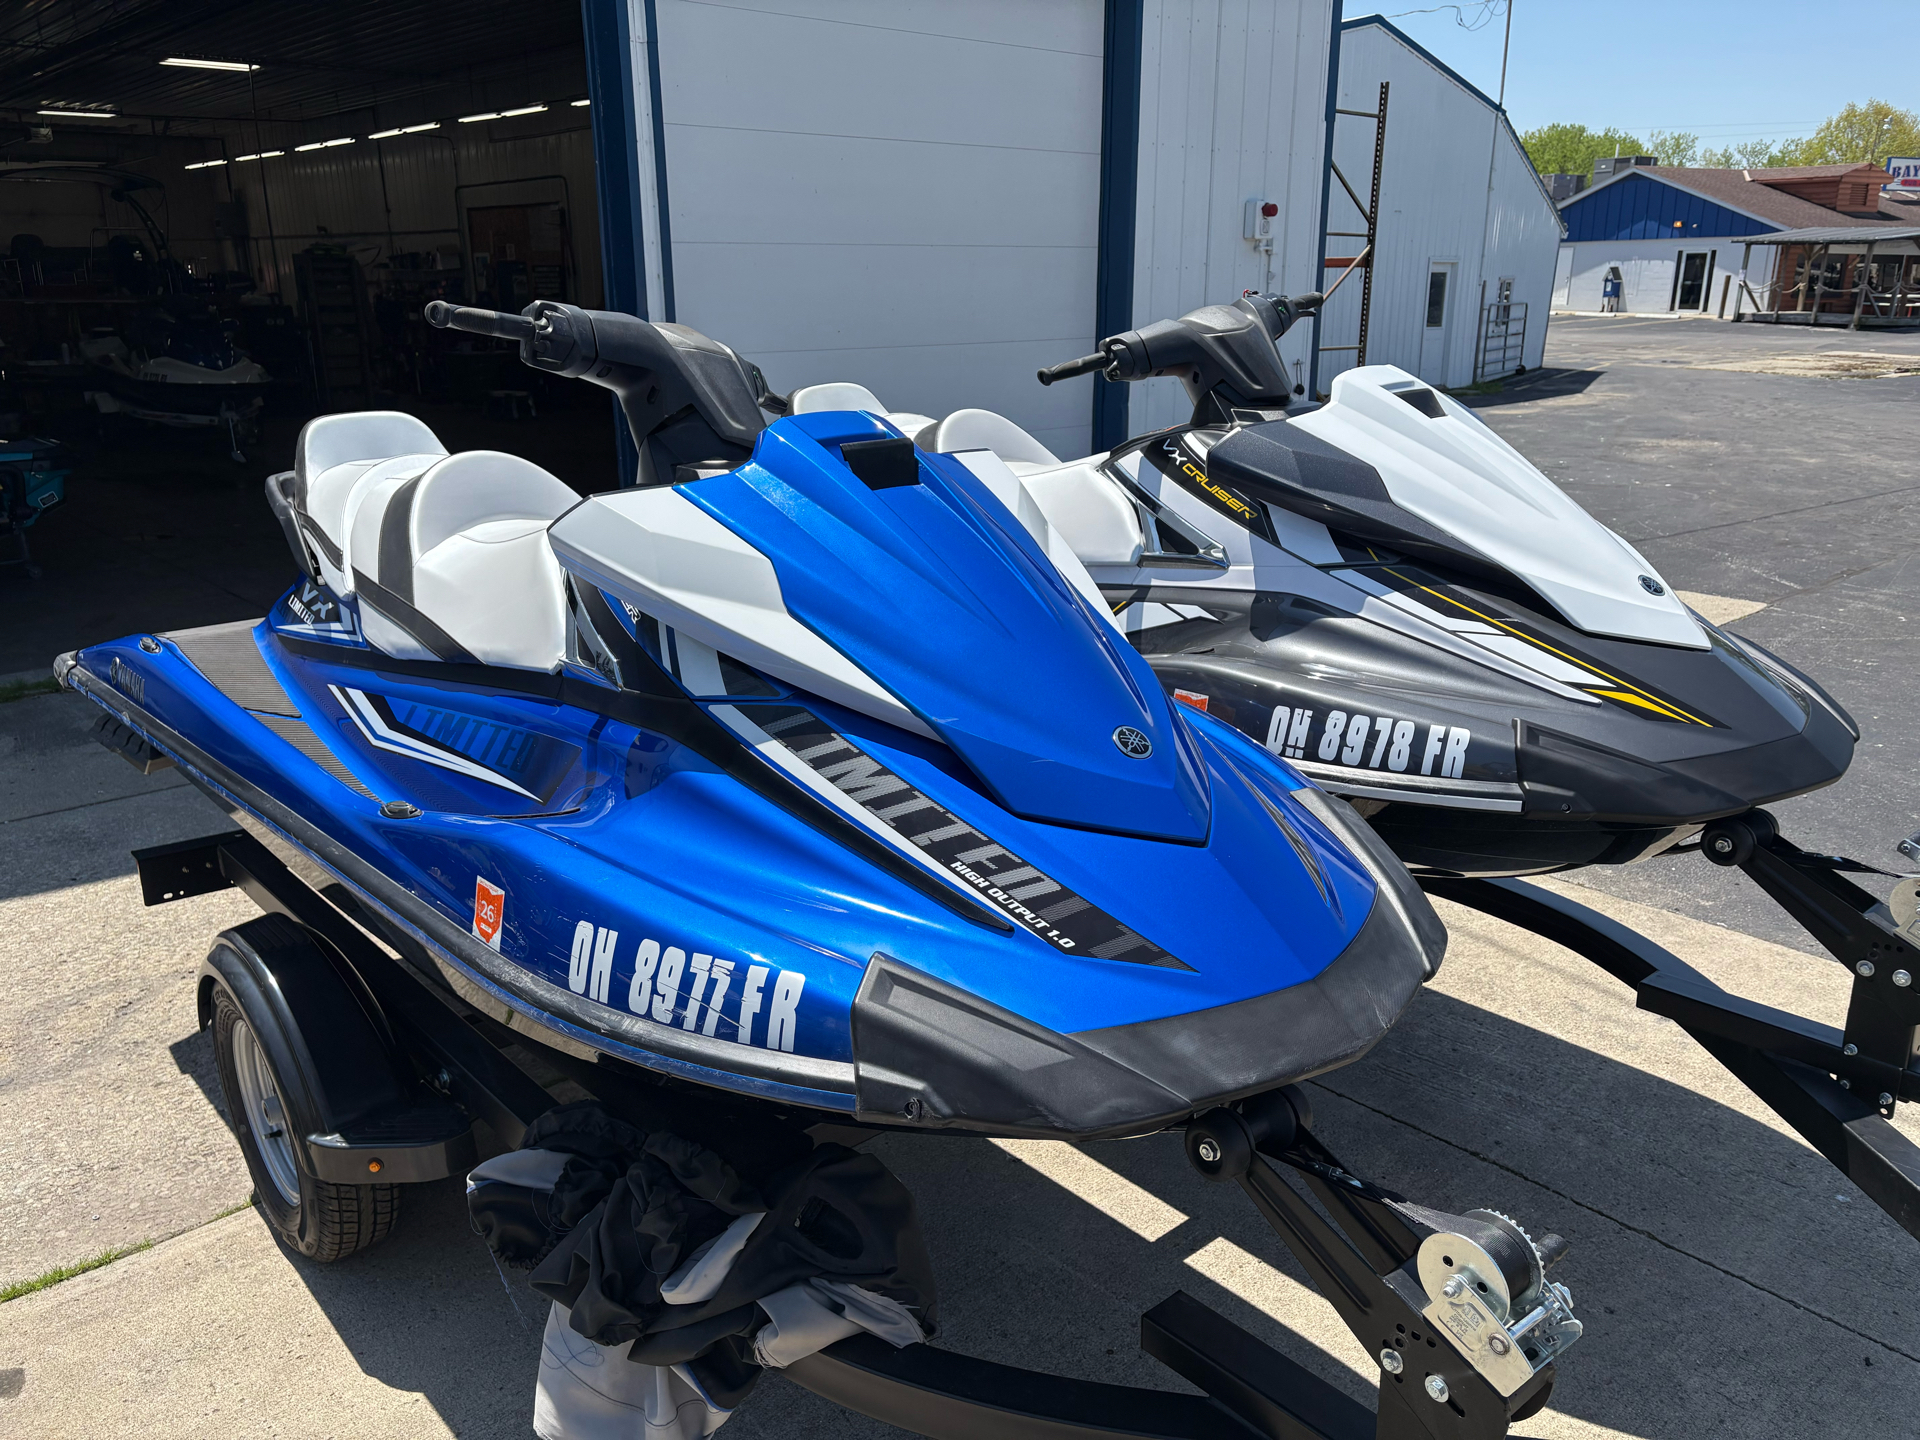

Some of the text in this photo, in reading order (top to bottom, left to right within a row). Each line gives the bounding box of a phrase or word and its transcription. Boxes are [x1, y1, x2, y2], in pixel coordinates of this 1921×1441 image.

[1162, 438, 1258, 519] VX CRUISER
[287, 594, 316, 626] LIMITED
[301, 582, 335, 620] VX
[401, 703, 540, 774] LIMITED
[1265, 705, 1471, 779] OH 8978 FR
[480, 900, 495, 923] 26
[949, 861, 991, 889] HIGH
[987, 887, 1051, 930] OUTPUT
[1046, 929, 1077, 949] 1.0
[568, 919, 807, 1053] OH 8977 FR
